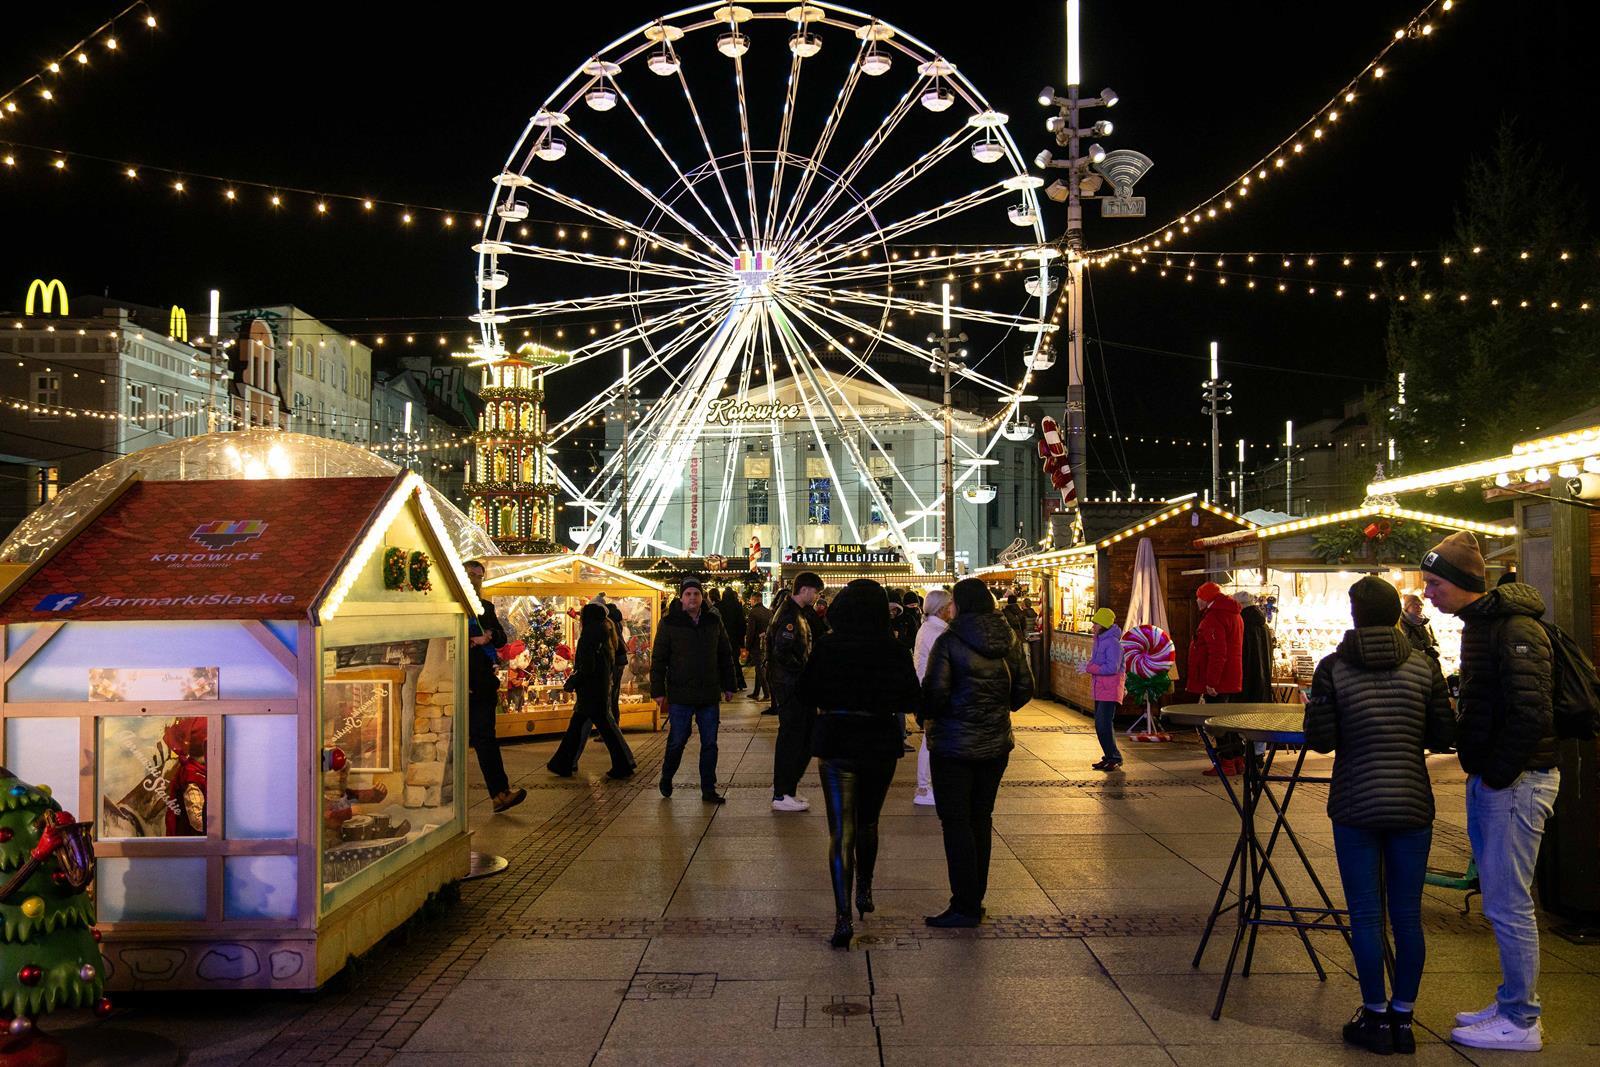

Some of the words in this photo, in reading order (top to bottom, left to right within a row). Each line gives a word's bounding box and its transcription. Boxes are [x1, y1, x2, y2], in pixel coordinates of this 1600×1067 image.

[707, 399, 800, 426] Katowice
[690, 495, 698, 529] strona
[150, 552, 263, 562] KATOWICE
[796, 553, 830, 562] FRYTKI
[836, 553, 895, 562] BELGIJSKIE
[79, 593, 296, 608] /JarmarkiSlaskie
